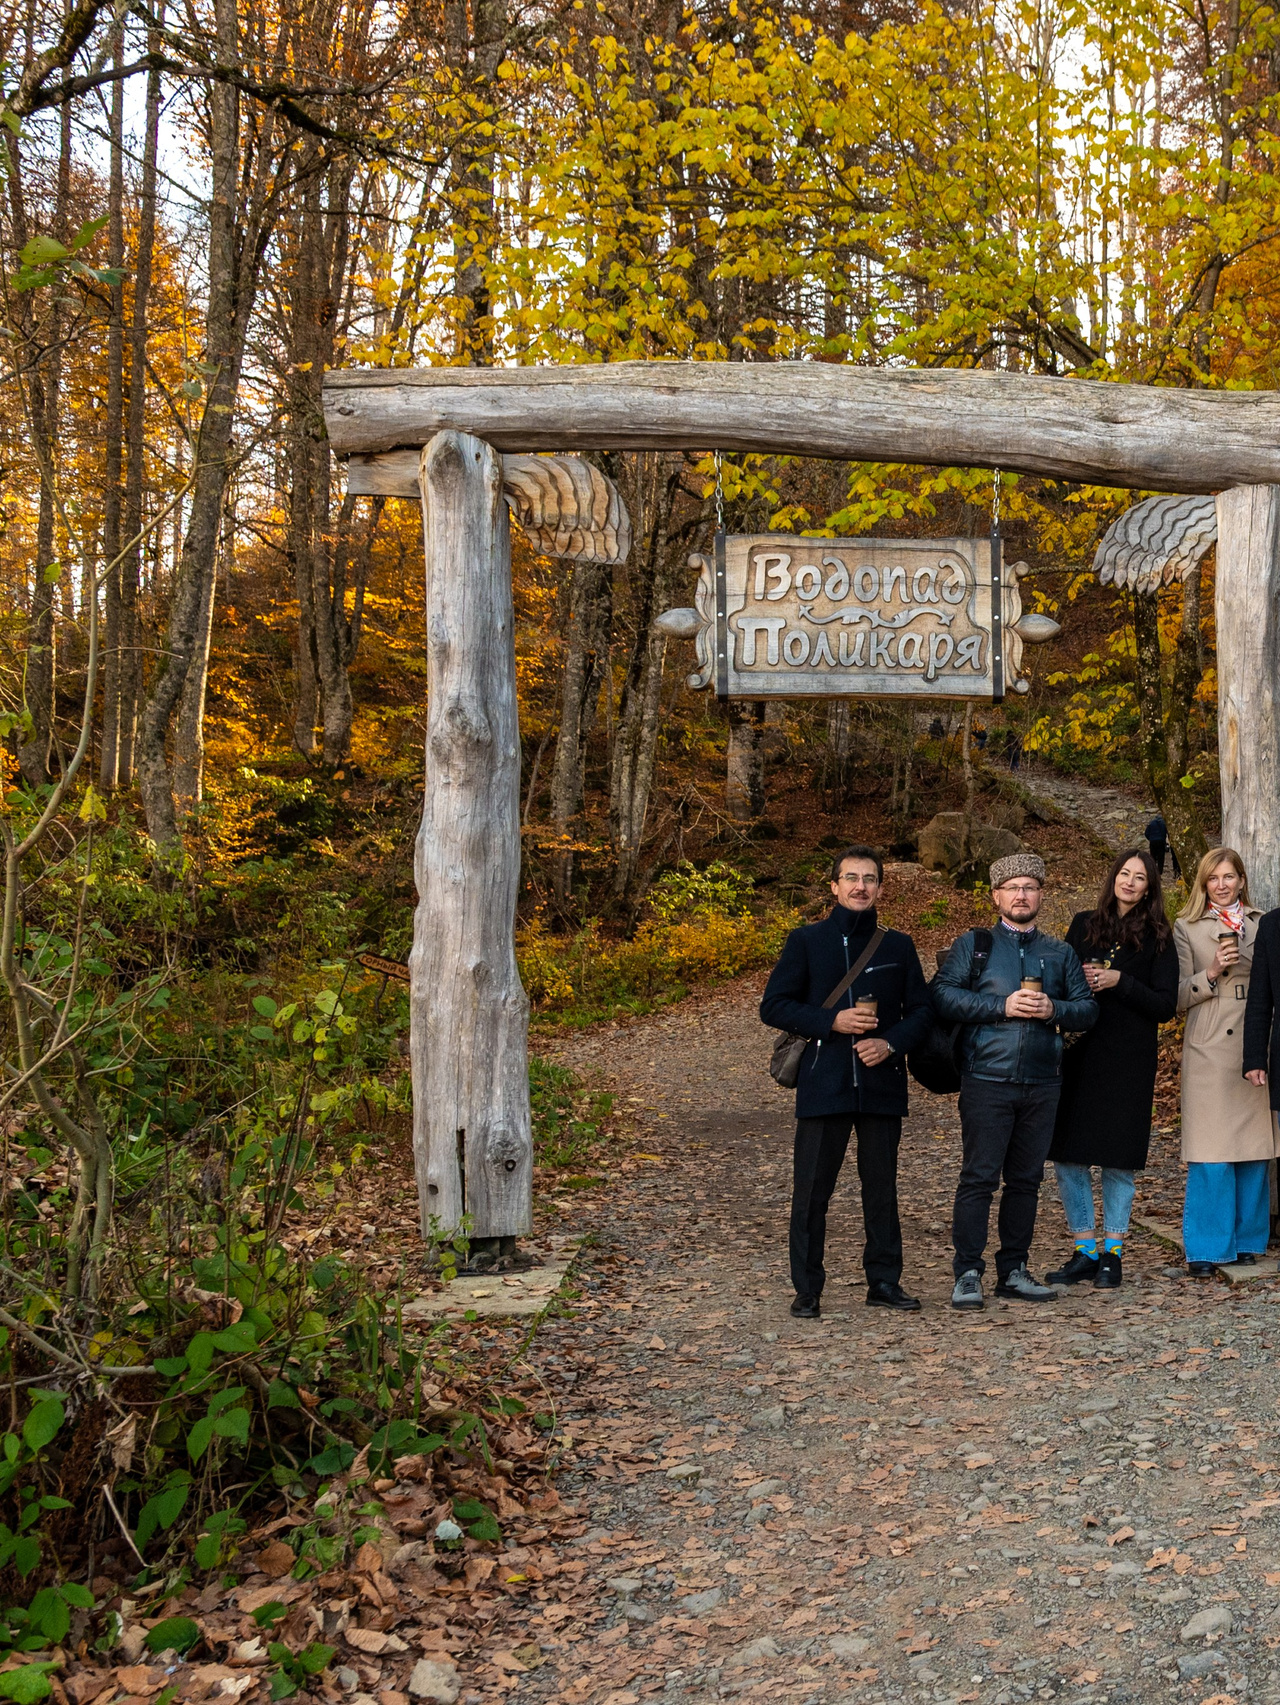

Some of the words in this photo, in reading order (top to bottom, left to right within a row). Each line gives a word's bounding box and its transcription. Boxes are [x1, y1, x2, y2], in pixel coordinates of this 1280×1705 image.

[753, 553, 966, 604] Водопад
[737, 617, 983, 680] Поликаря
[361, 955, 397, 973] ГОРНЫЙ
[398, 967, 411, 977] ЧА
